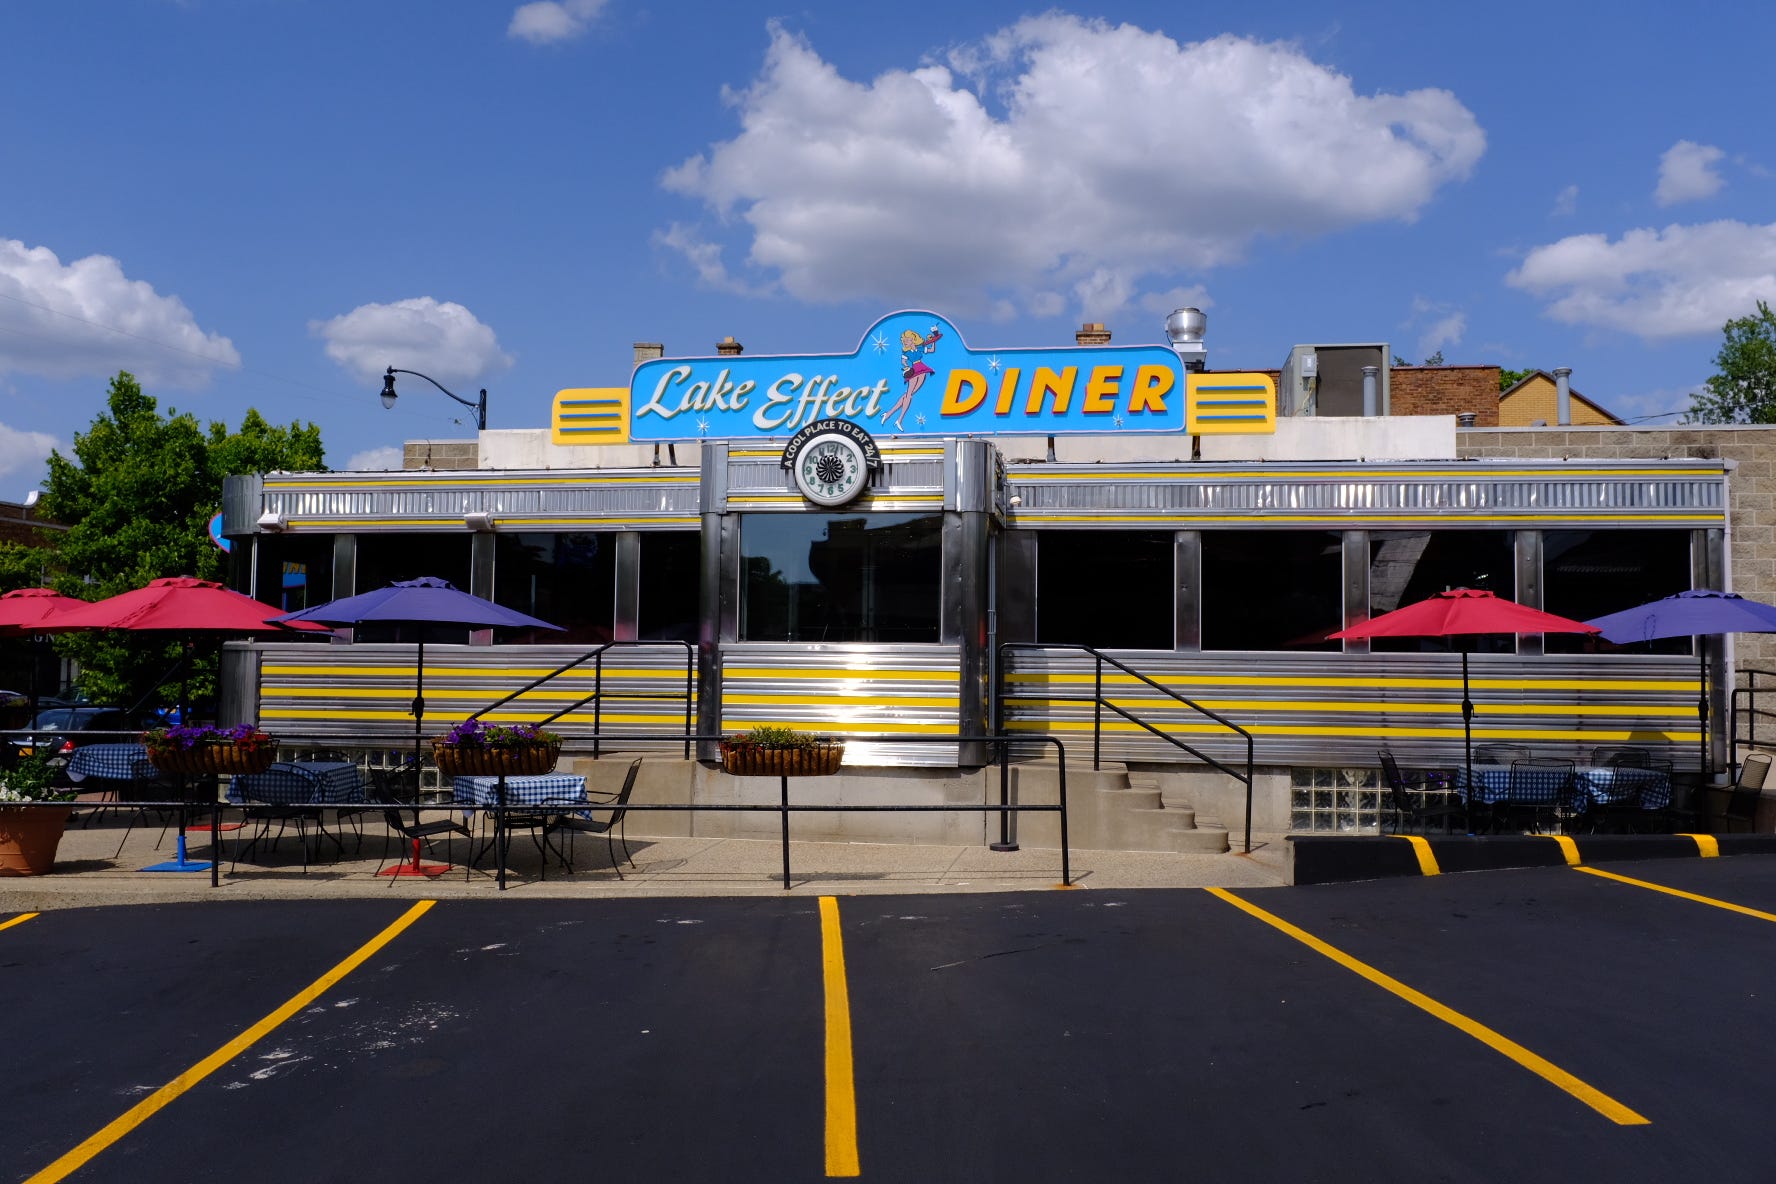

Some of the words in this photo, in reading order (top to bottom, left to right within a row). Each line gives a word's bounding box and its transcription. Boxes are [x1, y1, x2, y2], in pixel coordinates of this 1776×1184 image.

[636, 365, 756, 419] Lake
[753, 373, 889, 431] Effect
[939, 365, 1175, 416] DINER
[786, 434, 806, 459] COOL
[804, 421, 836, 437] PLACE
[838, 421, 852, 432] TO
[851, 427, 869, 443] EAT
[864, 443, 880, 467] 24/7
[827, 444, 836, 453] 12
[809, 456, 818, 464] 10
[846, 453, 853, 462] 2
[805, 466, 812, 475] 9
[850, 465, 856, 473] 3
[809, 476, 815, 485] 8
[845, 476, 852, 484] 4
[817, 483, 824, 493] 7
[828, 486, 834, 495] 6
[837, 483, 844, 492] 5
